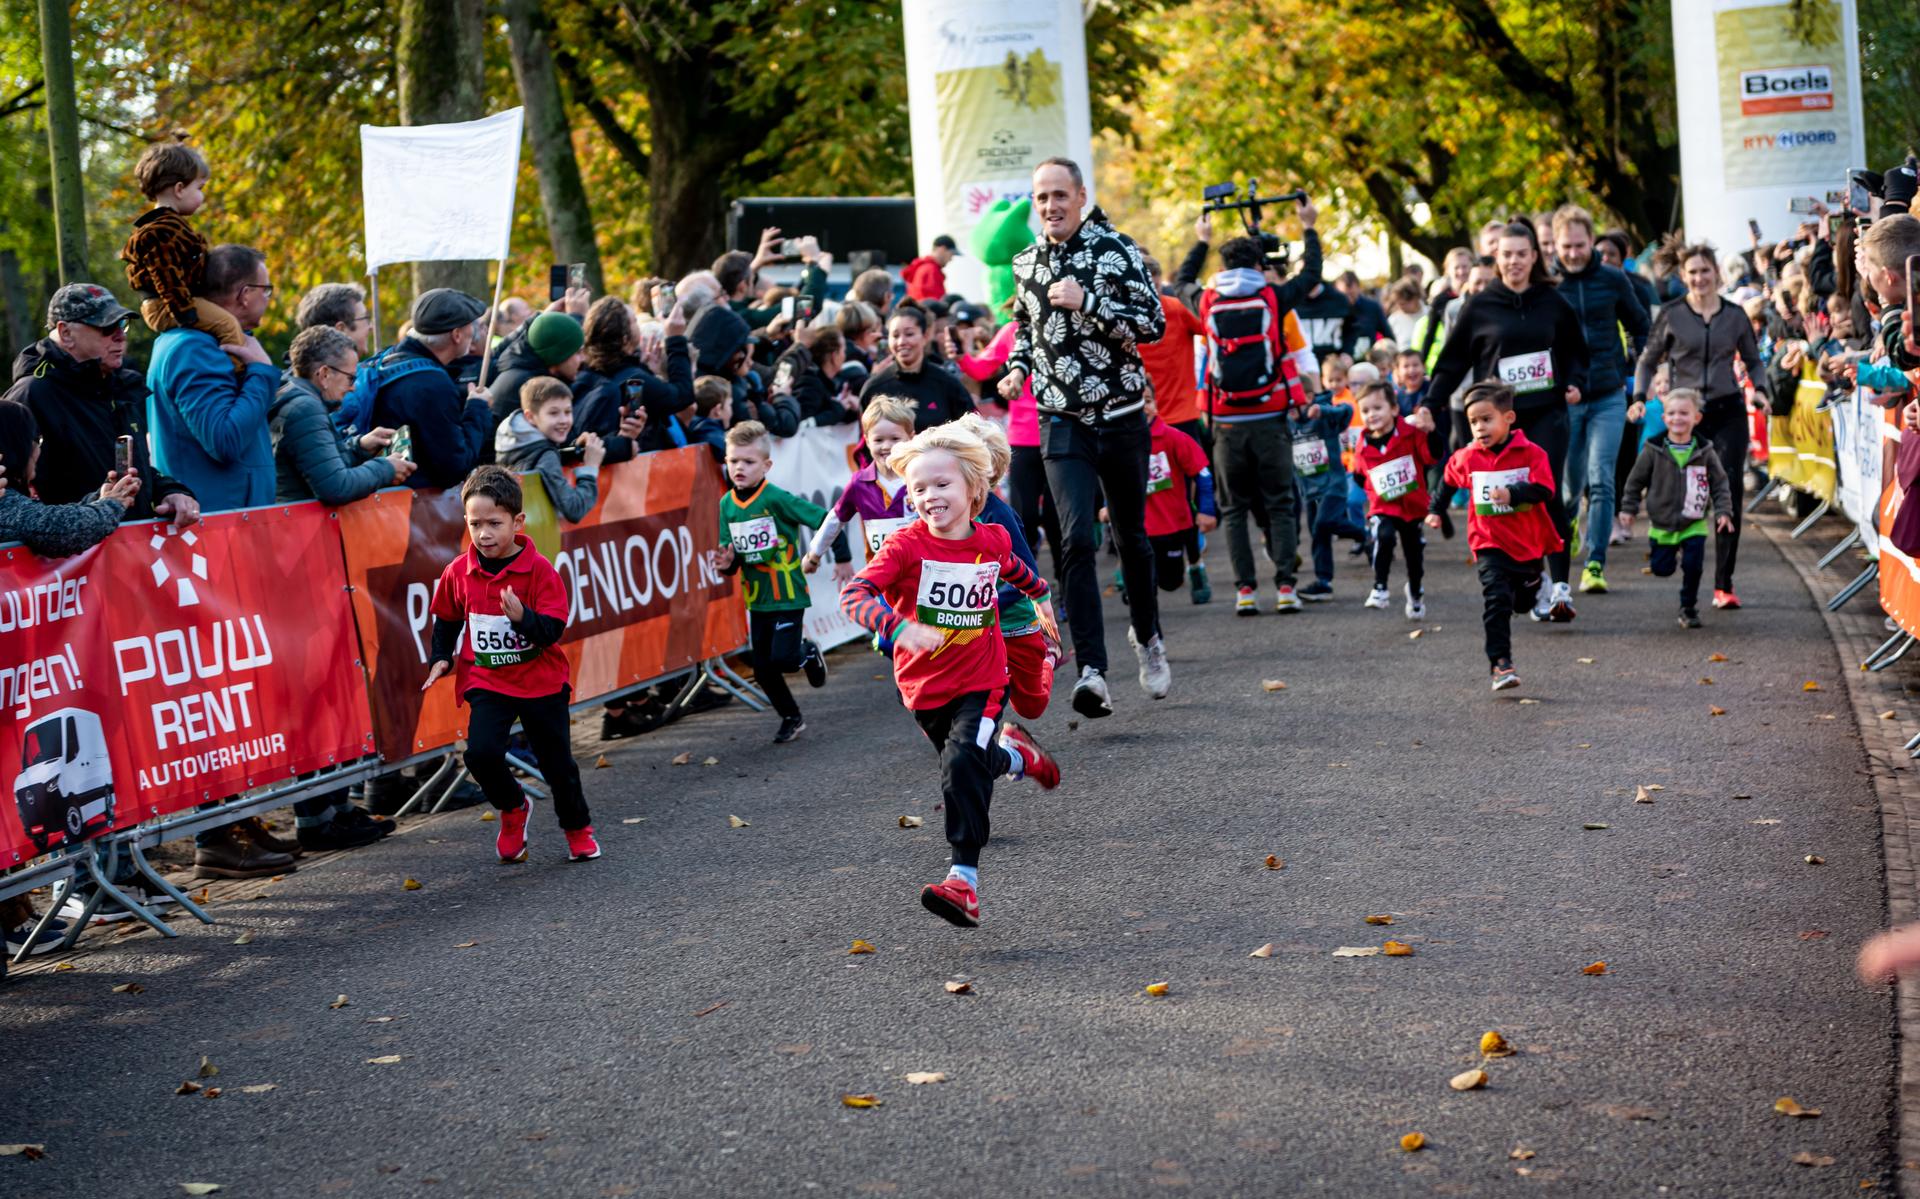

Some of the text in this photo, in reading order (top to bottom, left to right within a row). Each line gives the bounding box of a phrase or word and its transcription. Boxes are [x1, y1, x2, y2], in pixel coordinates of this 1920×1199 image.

[1746, 70, 1829, 94] Boels
[1744, 134, 1776, 150] RTV
[1379, 468, 1409, 490] 5571
[734, 531, 769, 550] 5099
[928, 581, 993, 608] 5060
[936, 612, 983, 627] BRONNE
[477, 631, 531, 651] 5568
[113, 614, 273, 697] POUW
[490, 654, 521, 665] ELYON
[151, 682, 254, 750] RENT
[138, 733, 286, 791] AUTOVERHUUR
